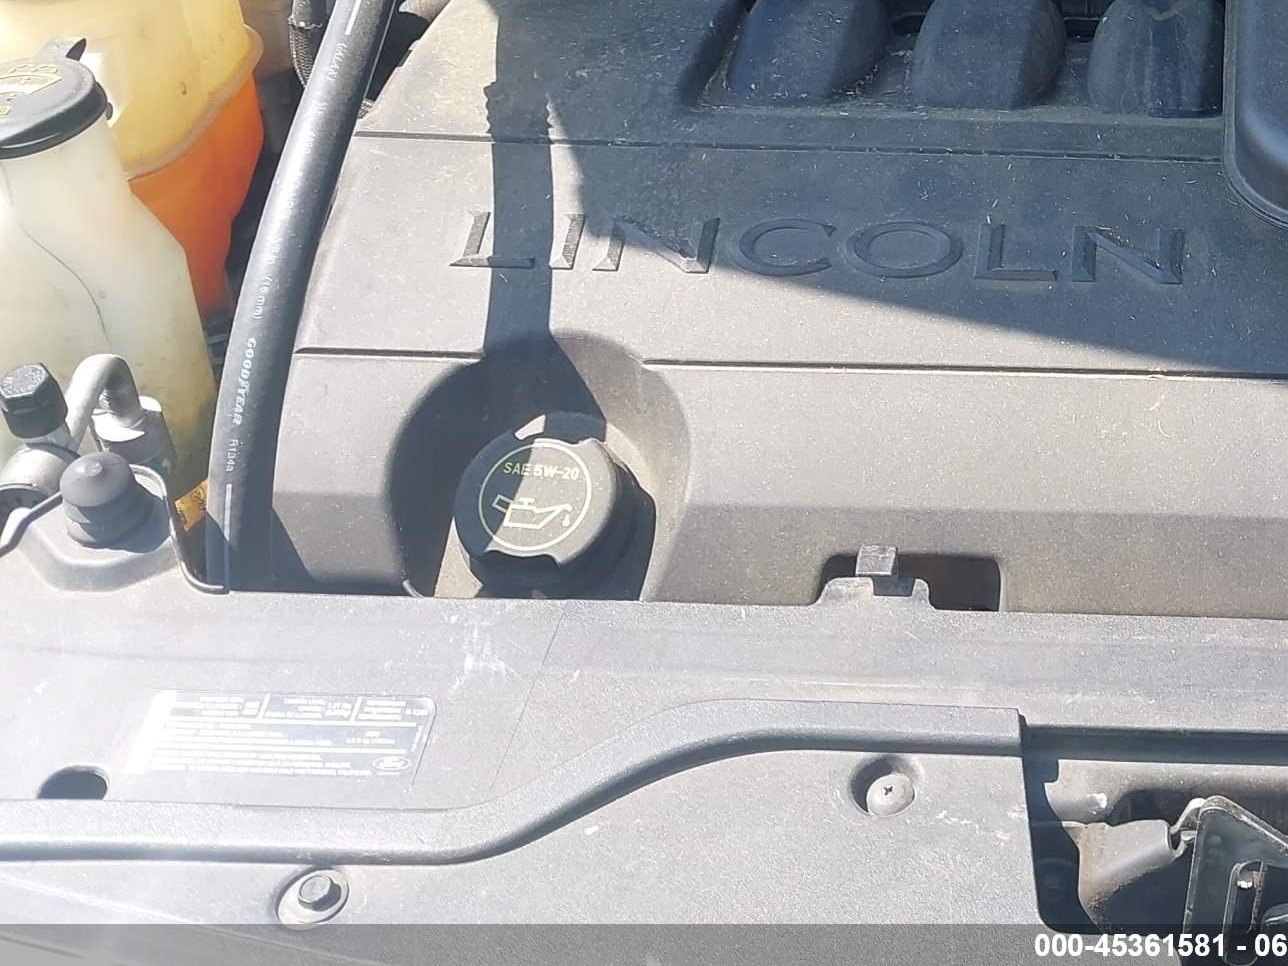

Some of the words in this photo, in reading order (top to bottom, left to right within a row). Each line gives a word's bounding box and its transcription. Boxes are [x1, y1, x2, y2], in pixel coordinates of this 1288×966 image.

[450, 211, 1185, 285] LINCOLN
[232, 337, 258, 426] GOODYEAR
[503, 461, 533, 476] SAE
[534, 464, 580, 481] 5W-20
